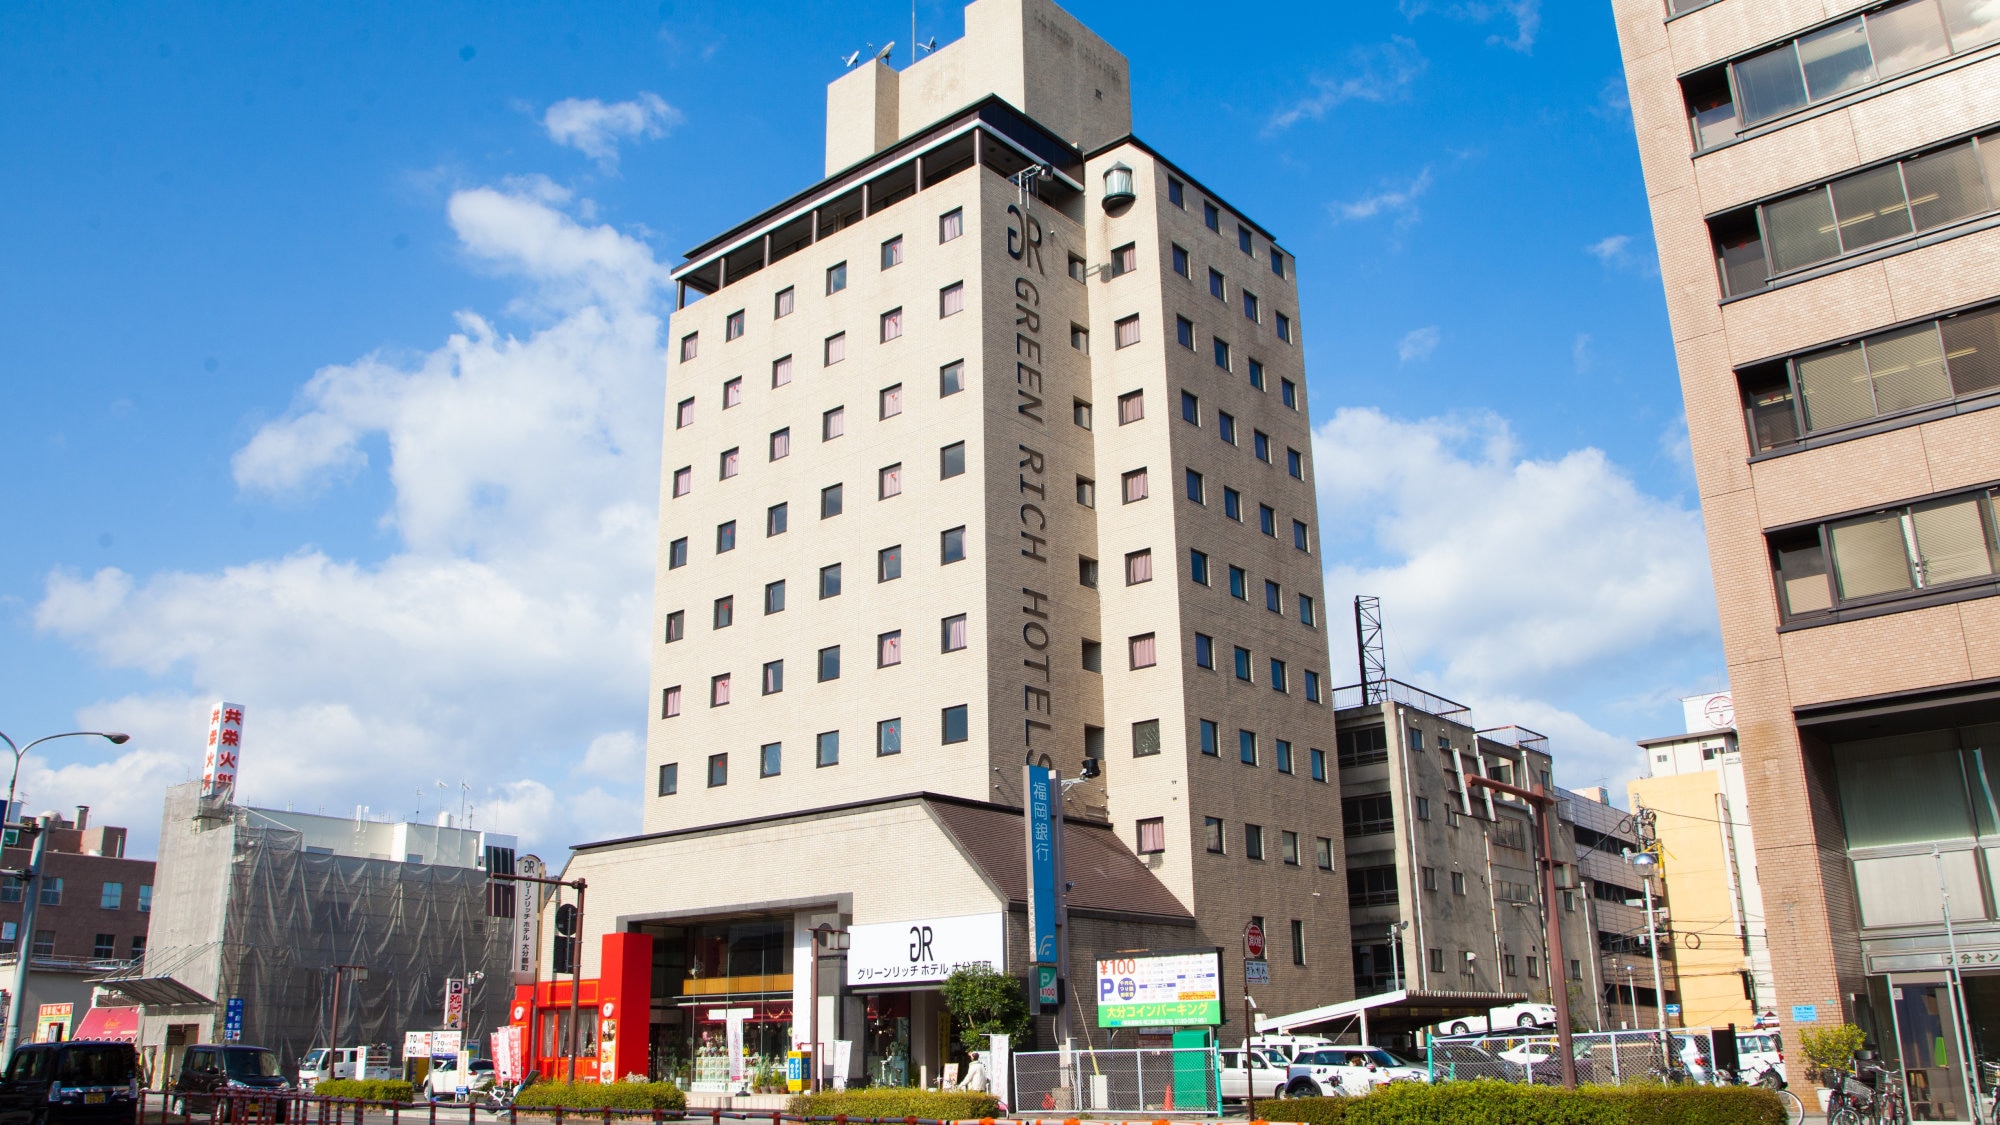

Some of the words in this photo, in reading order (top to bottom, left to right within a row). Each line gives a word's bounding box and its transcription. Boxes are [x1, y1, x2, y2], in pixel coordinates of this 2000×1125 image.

[1015, 277, 1043, 424] GREEN
[1018, 443, 1047, 563] RICH
[1032, 781, 1049, 861] 福岡銀行
[523, 874, 533, 919] リーンリッチ
[522, 921, 530, 940] ホテル
[857, 964, 919, 980] グリーンリッチ
[921, 963, 949, 976] ホテル
[1100, 958, 1136, 976] ¥100
[451, 981, 462, 993] P
[1041, 972, 1051, 986] P
[1100, 978, 1115, 1002] P
[1106, 1002, 1209, 1018] 大分コインパーキング
